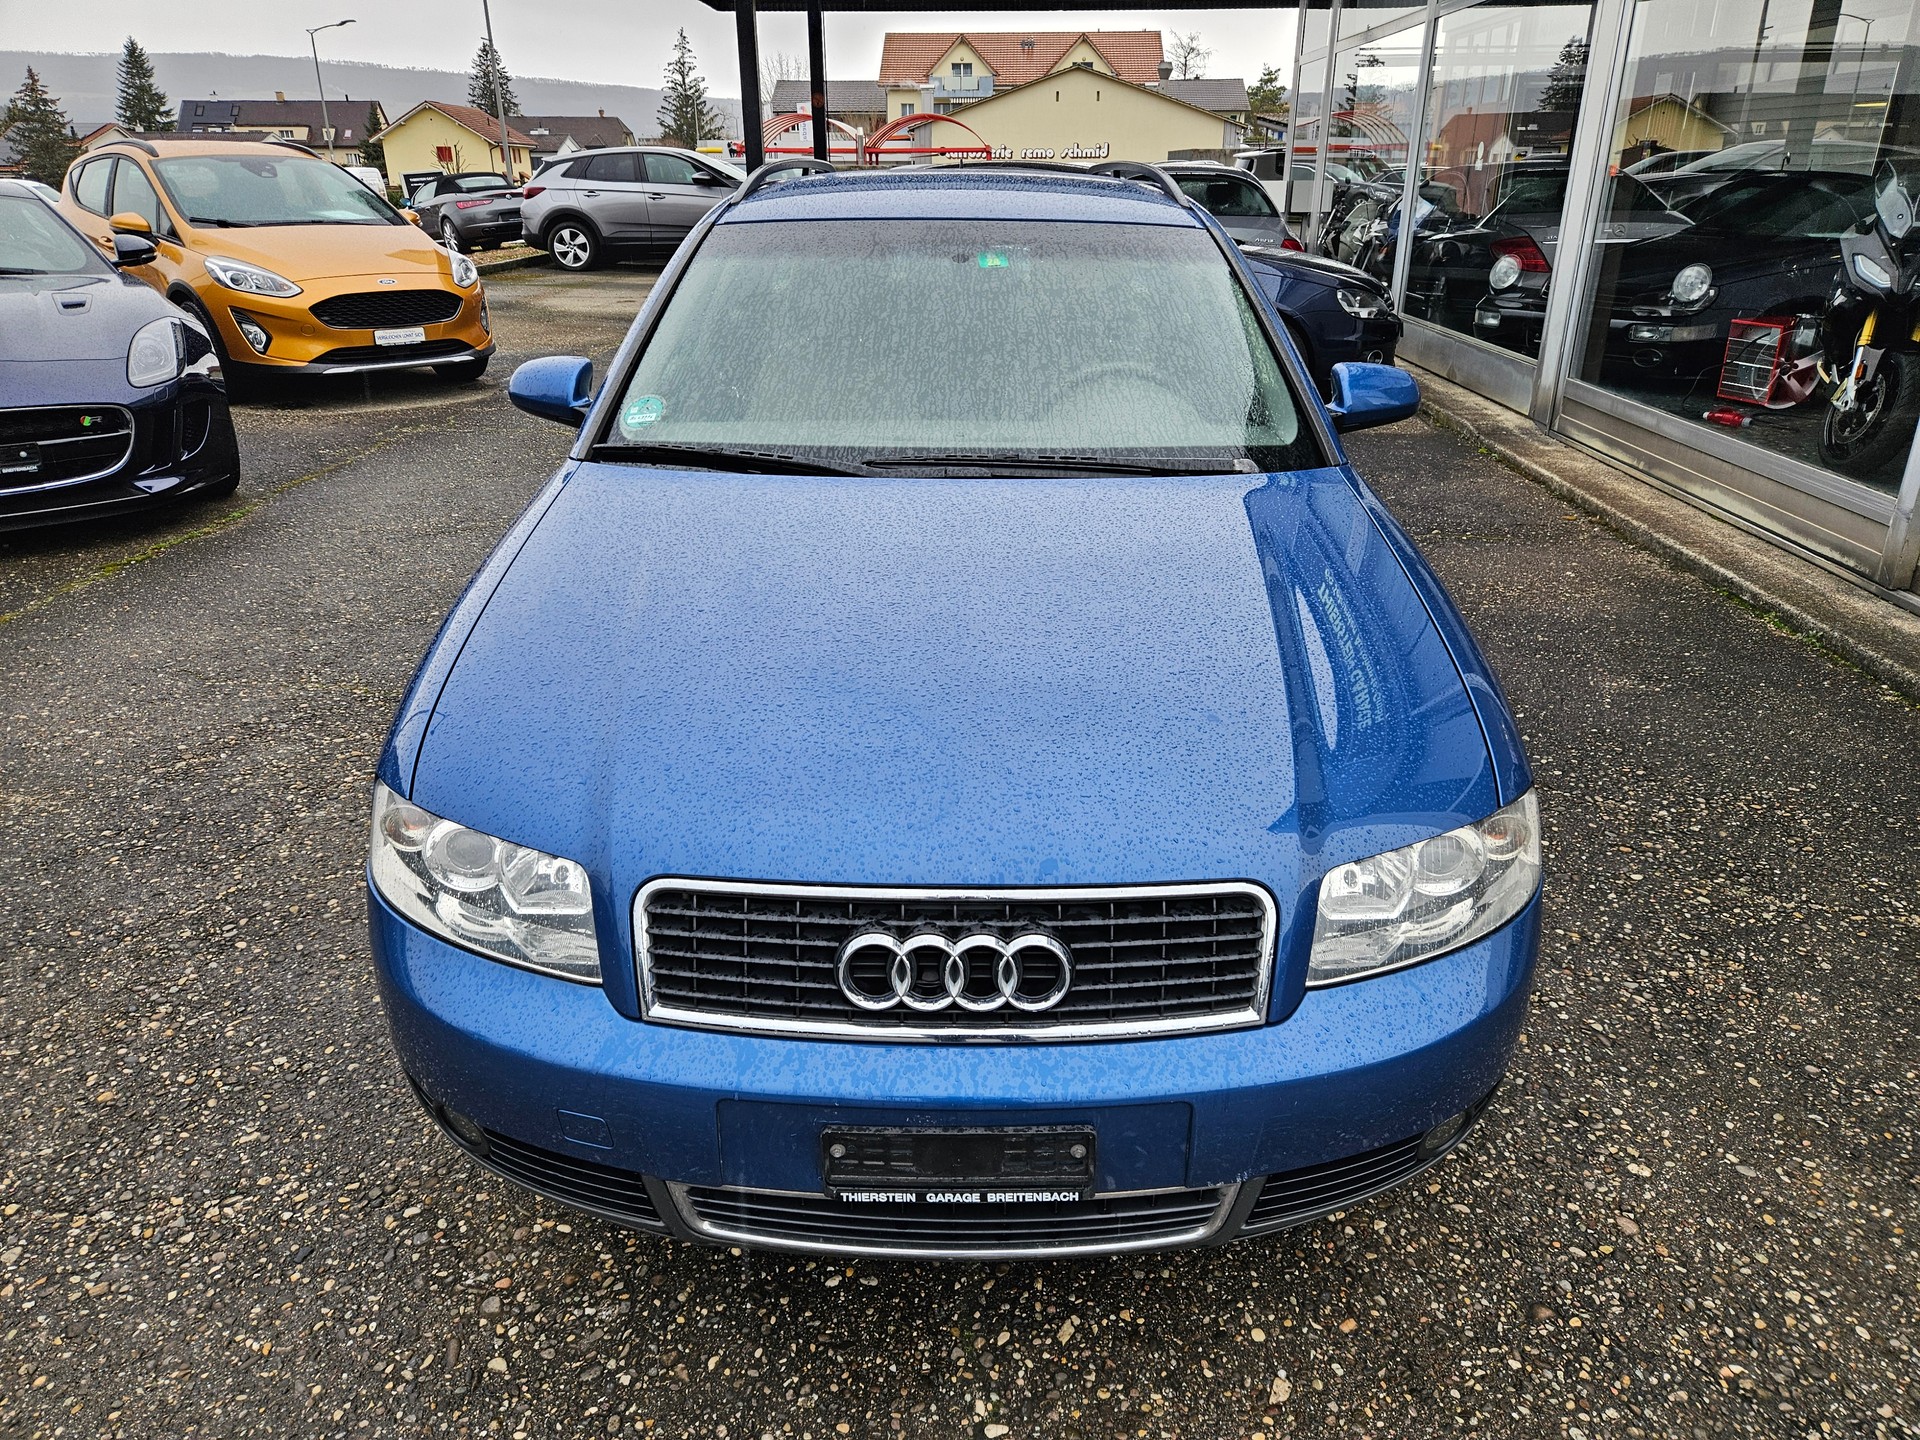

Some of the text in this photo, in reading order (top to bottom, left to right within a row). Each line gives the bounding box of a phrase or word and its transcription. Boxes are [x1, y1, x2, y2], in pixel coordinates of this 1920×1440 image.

[1020, 148, 1055, 159] remo
[1060, 142, 1110, 159] schmid
[840, 1191, 1080, 1203] THIERSTEIN GARAGE BREITENBACH
